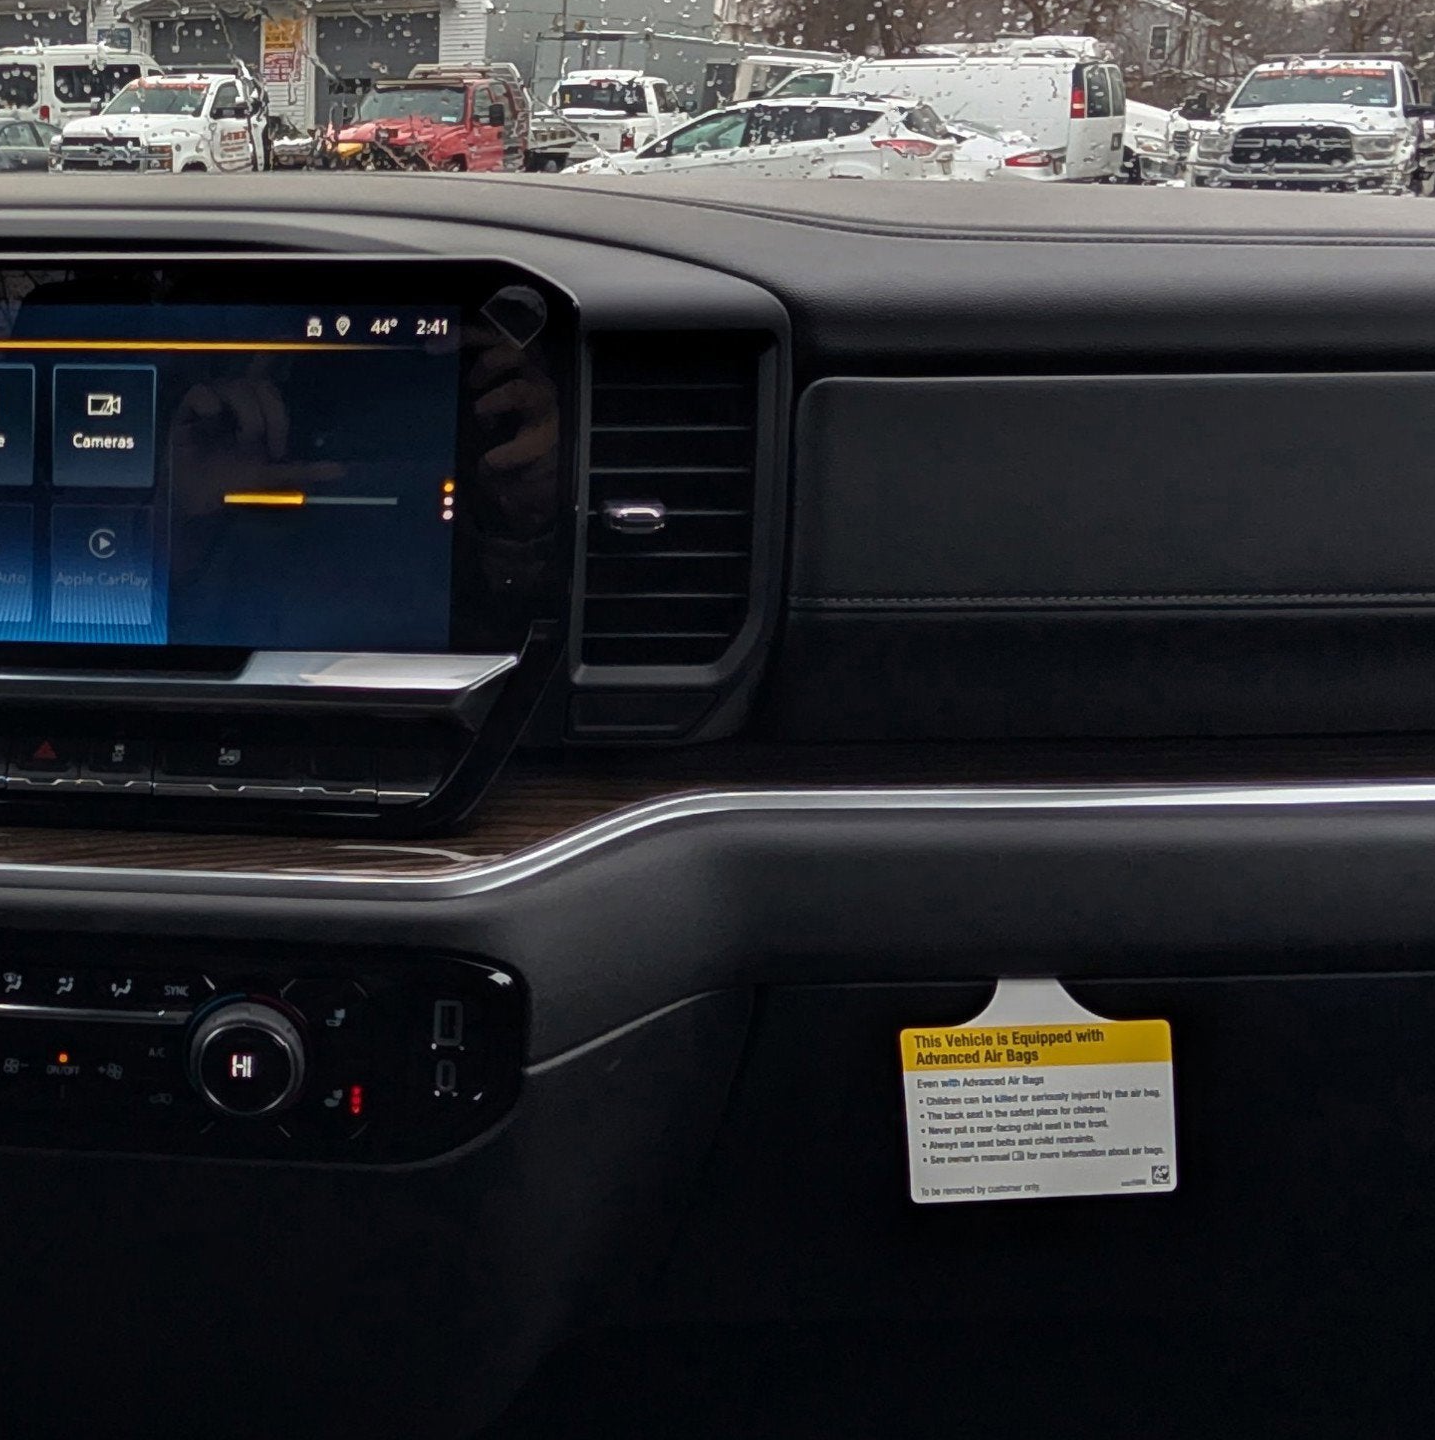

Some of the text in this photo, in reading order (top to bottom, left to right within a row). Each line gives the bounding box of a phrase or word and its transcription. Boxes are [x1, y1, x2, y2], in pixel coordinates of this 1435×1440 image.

[370, 317, 399, 335] 44°
[416, 318, 449, 335] 2:41
[72, 432, 135, 451] Cameras
[55, 571, 149, 589] Apple CarPlay
[164, 985, 189, 997] SYNC
[914, 1029, 1105, 1048] This Vehicle is Equipped with
[148, 1047, 166, 1059] A/C
[916, 1048, 1039, 1065] Advanced Air Bags
[46, 1065, 80, 1076] ON/OFF
[917, 1075, 1044, 1089] Even with Advanced Air Bags
[926, 1096, 962, 1106] Children
[964, 1097, 980, 1105] can
[982, 1095, 992, 1103] be
[995, 1094, 1017, 1103] killed
[1031, 1092, 1069, 1101] seriously
[1071, 1090, 1100, 1101] injured
[1103, 1090, 1112, 1100] by
[1115, 1089, 1128, 1098] the
[927, 1112, 942, 1120] The
[944, 1111, 963, 1120] back
[995, 1109, 1007, 1118] the
[1036, 1107, 1058, 1117] place
[1060, 1106, 1071, 1115] for
[921, 1187, 929, 1196] To
[931, 1187, 941, 1195] be
[943, 1186, 975, 1195] removed
[977, 1186, 986, 1195] by
